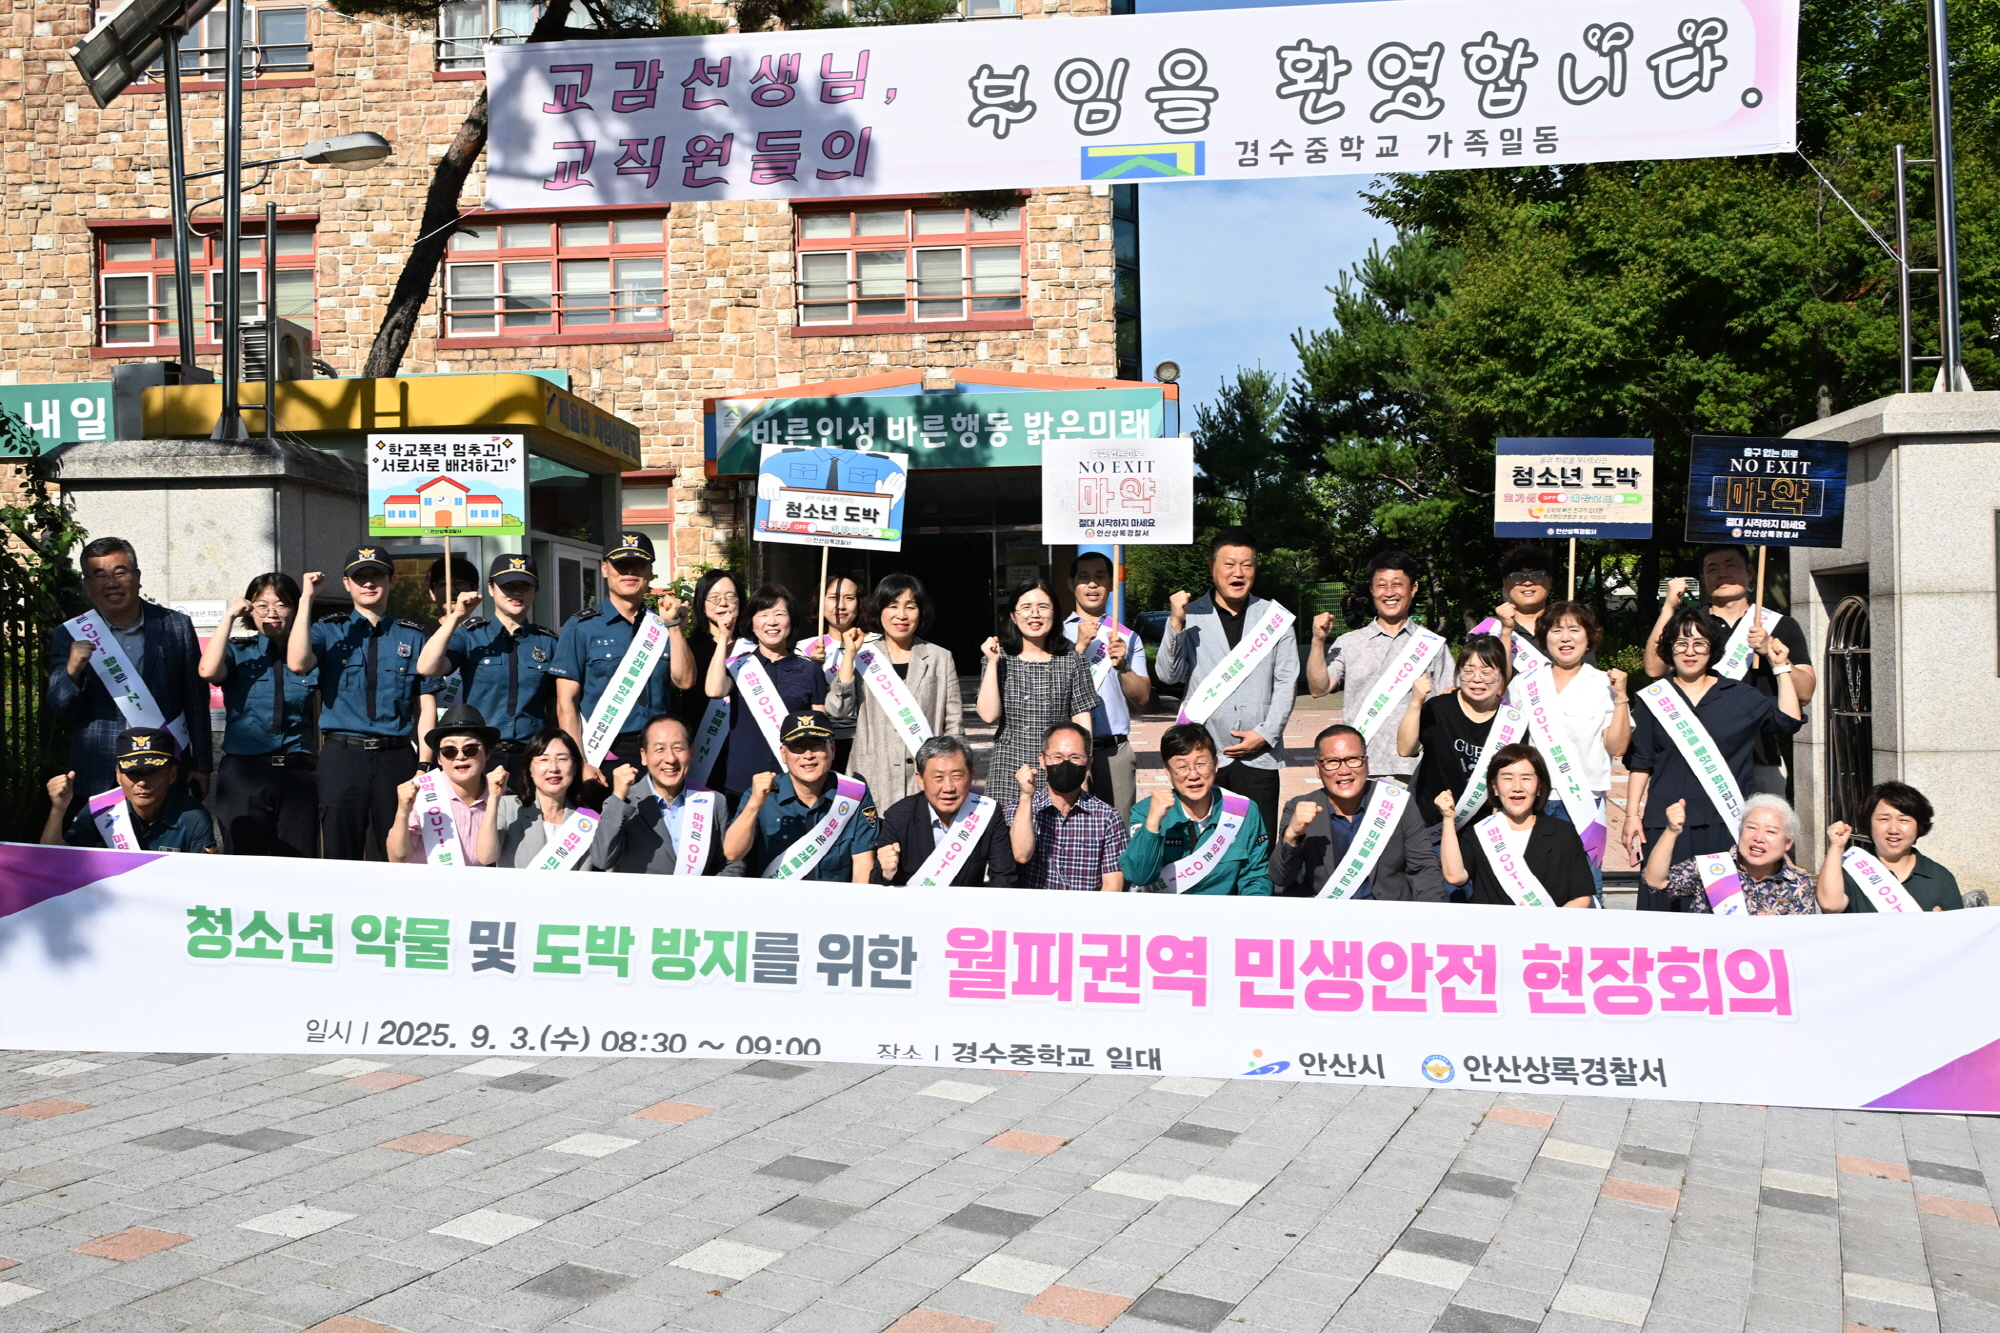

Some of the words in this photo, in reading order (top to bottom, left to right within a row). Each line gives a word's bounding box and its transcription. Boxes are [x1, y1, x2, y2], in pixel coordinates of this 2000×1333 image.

[541, 49, 897, 114] 교감선생님,
[967, 47, 1219, 140] 부임을
[1276, 17, 1763, 125] 환영합니다.
[541, 126, 873, 191] 교직원들의
[1235, 134, 1399, 168] 경수중학교
[1427, 125, 1560, 159] 가족일동
[23, 397, 107, 441] 내일
[887, 412, 1013, 449] 바른행동
[1024, 409, 1151, 445] 밝은미래
[388, 443, 447, 457] 학교폭력
[453, 443, 501, 457] 멈추고!
[381, 459, 440, 472] 서로서로
[445, 459, 509, 472] 배려하고!
[1079, 461, 1105, 474] NO
[1112, 460, 1155, 474] EXIT
[1512, 466, 1583, 488] 청소년
[1592, 467, 1642, 489] 도박
[1730, 459, 1759, 473] NO
[1765, 460, 1811, 475] EXIT
[1078, 477, 1156, 514] 마약
[1726, 476, 1810, 515] 마약
[786, 501, 838, 521] 청소년
[843, 506, 880, 524] 도박
[1078, 518, 1095, 527] 절대
[1097, 518, 1129, 527] 시작하지
[1131, 518, 1155, 527] 마세요
[1725, 518, 1743, 527] 절대
[1745, 518, 1779, 529] 시작하지
[1781, 520, 1806, 530] 마세요
[1097, 529, 1149, 537] 안산상록경찰서
[1743, 529, 1798, 538] 안산상록경찰서
[1265, 613, 1284, 635] 마약은
[642, 625, 661, 652] 마약은
[1243, 632, 1269, 659] OUT!
[1410, 641, 1429, 664] 마약은
[628, 650, 649, 677] 미래를
[1388, 662, 1414, 693] OUT!
[125, 685, 142, 710] IN!
[612, 676, 635, 705] 빼앗는
[743, 671, 765, 696] 마약은
[859, 652, 881, 674] 마약은
[876, 674, 901, 705] OUT!
[898, 706, 921, 735] 행복은
[1202, 682, 1221, 702] IN!
[1527, 680, 1540, 706] 마약은
[587, 704, 619, 754] 범죄입니다.
[1533, 707, 1554, 742] OUT!
[1658, 696, 1682, 721] 마약은
[1676, 720, 1700, 746] 미래를
[1693, 745, 1718, 774] 빼앗는
[699, 738, 711, 763] IN!
[1549, 745, 1571, 774] 행복은
[1567, 775, 1582, 801] IN!
[418, 775, 438, 802] 마약은
[428, 806, 446, 848] OUT!
[1373, 799, 1394, 829] 마약은
[691, 812, 705, 841] 마약은
[815, 818, 839, 846] 마약은
[958, 811, 980, 841] 마약은
[555, 832, 581, 859] 마약은
[790, 844, 818, 869] 미래를
[1203, 835, 1226, 862] 마약은
[1358, 829, 1381, 858] 미래를
[934, 842, 962, 876] OUT!
[1169, 861, 1204, 882] OUT!
[1487, 827, 1507, 853] 마약은
[1499, 854, 1524, 889] OUT!
[1854, 859, 1883, 885] 마약은
[1339, 858, 1364, 887] 빼앗는
[186, 905, 333, 964] 청소년
[351, 914, 451, 970] 약물
[468, 920, 516, 974] 및
[532, 924, 635, 978] 도박
[650, 927, 800, 985] 방지를
[817, 933, 918, 990] 위한
[944, 926, 1208, 1007] 월피권역
[1234, 937, 1498, 1014] 민생안전
[1522, 942, 1793, 1016] 현장회의
[306, 1019, 352, 1044] 일시
[377, 1019, 457, 1049] 2025.
[470, 1024, 497, 1050] 9.
[601, 1030, 687, 1053] 08:30
[735, 1034, 821, 1056] 09:00
[876, 1042, 924, 1061] 장소
[951, 1041, 1094, 1068] 경수중학교
[1105, 1045, 1162, 1072] 일대
[1298, 1052, 1385, 1079] 안산시
[1463, 1055, 1667, 1088] 안산상록경찰서
